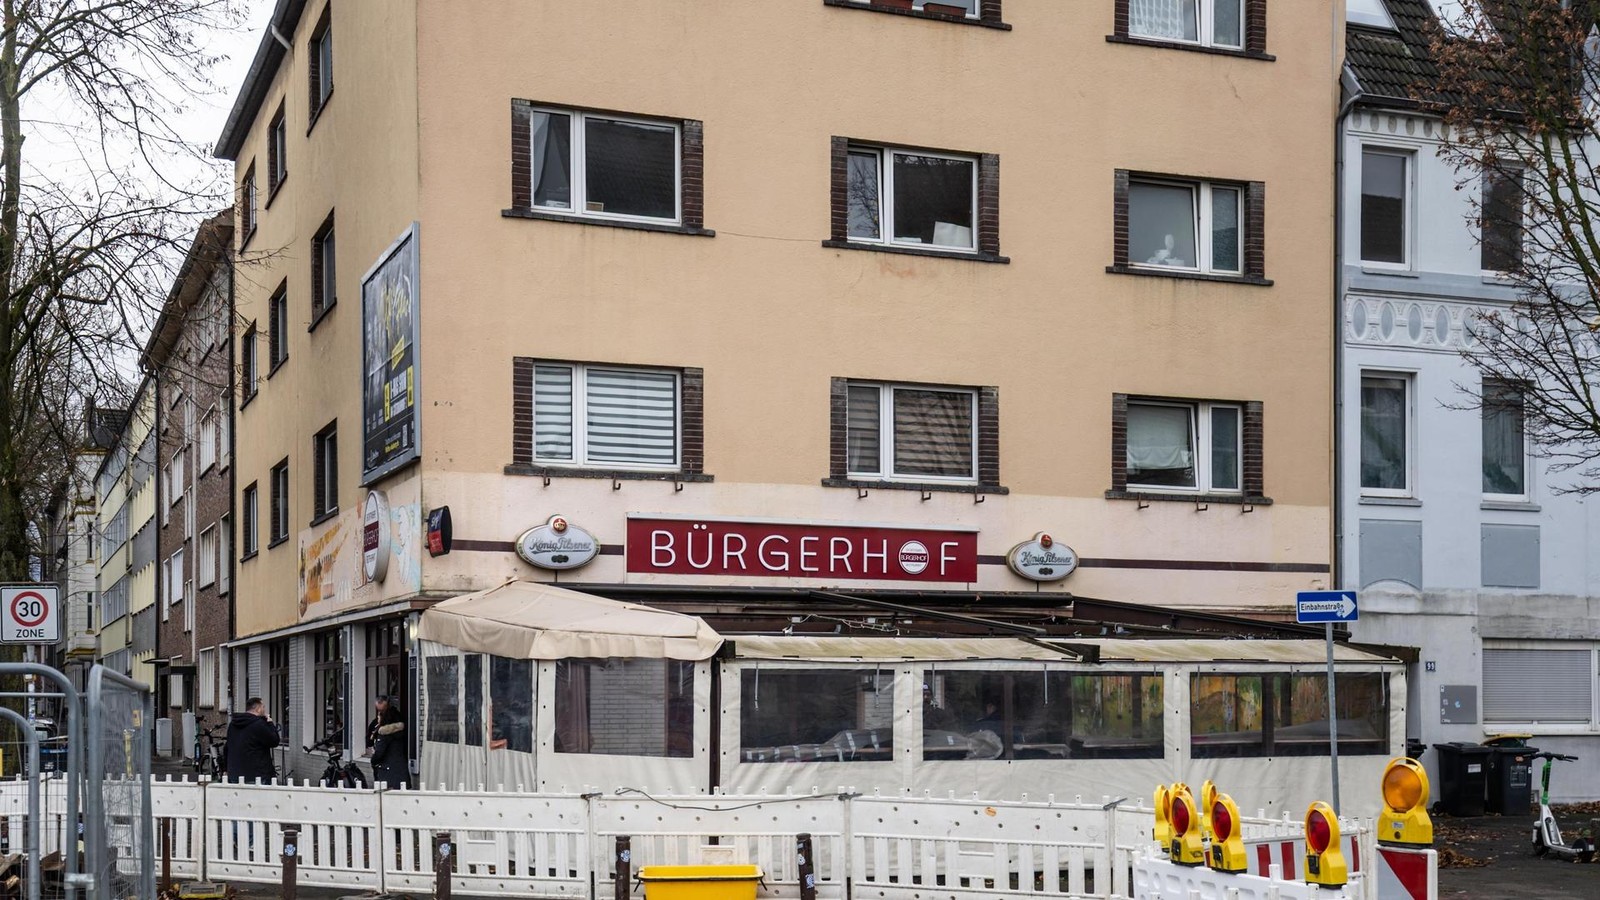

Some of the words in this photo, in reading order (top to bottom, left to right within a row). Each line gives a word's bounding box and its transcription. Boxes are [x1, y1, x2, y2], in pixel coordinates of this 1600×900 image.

[558, 537, 591, 550] Pilsener
[651, 523, 959, 576] BÜRGERHOF
[1044, 551, 1072, 563] Pilsener
[19, 601, 40, 617] 30
[16, 629, 44, 638] ZONE
